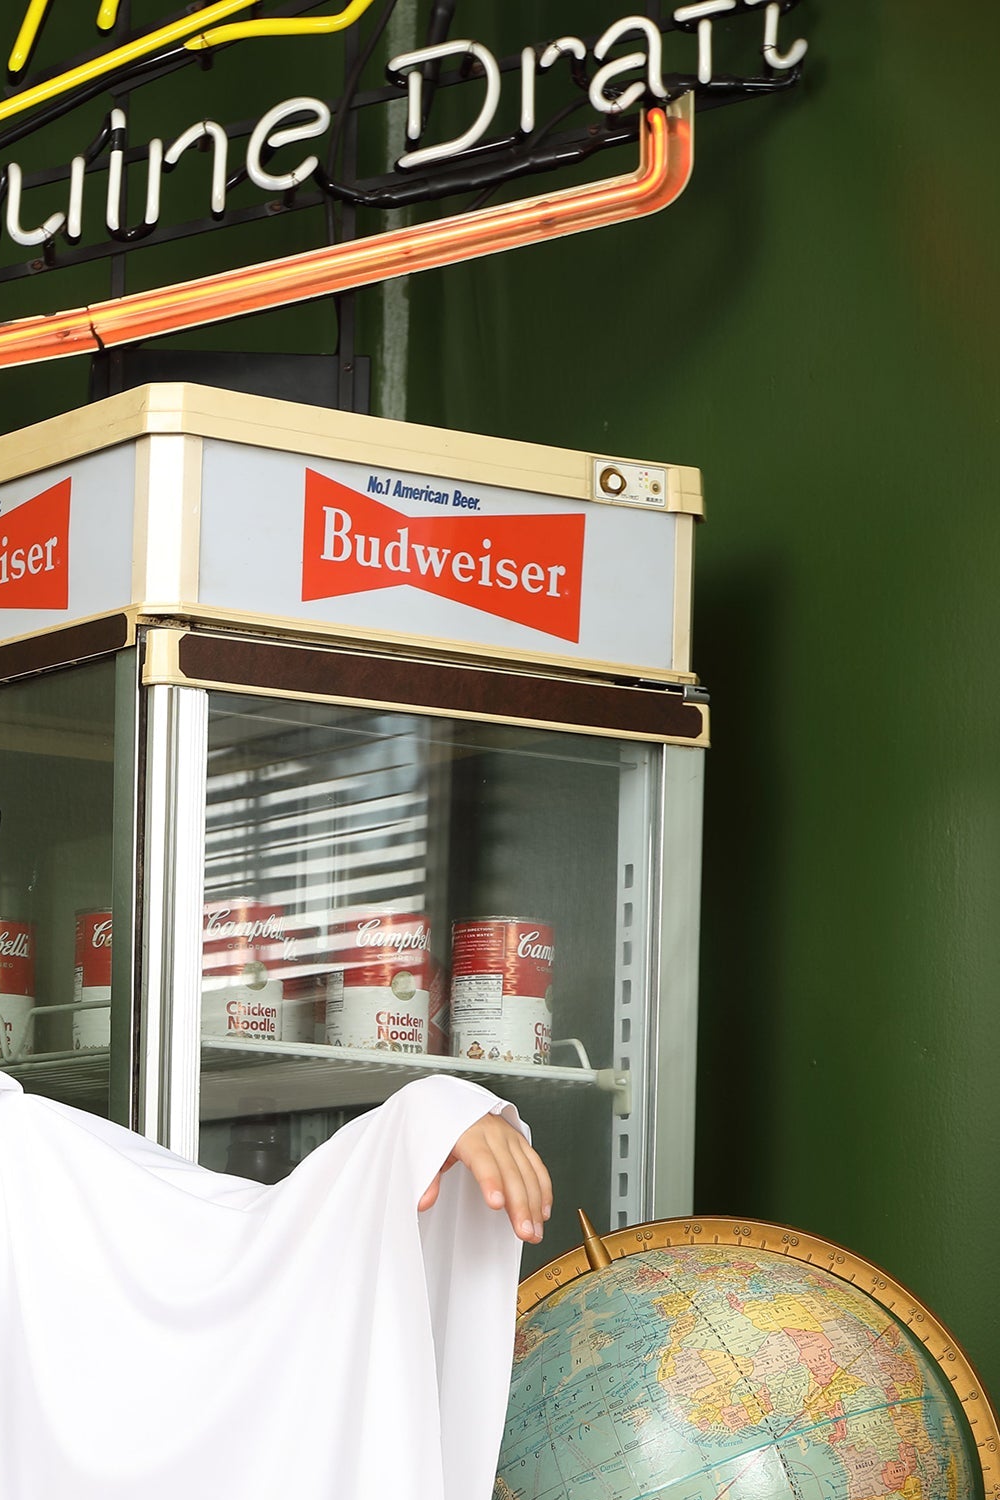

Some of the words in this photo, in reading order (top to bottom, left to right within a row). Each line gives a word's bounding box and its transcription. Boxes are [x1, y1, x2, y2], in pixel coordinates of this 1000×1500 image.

[367, 475, 390, 495] No.1
[393, 480, 449, 506] American
[452, 490, 481, 511] Beer.
[320, 506, 567, 598] Budweiser
[226, 1001, 277, 1018] Chicken
[227, 1016, 276, 1032] Noodle
[375, 1011, 424, 1028] Chicken
[377, 1026, 423, 1042] Noodle
[733, 1226, 751, 1236] 60
[782, 1234, 799, 1246] 50
